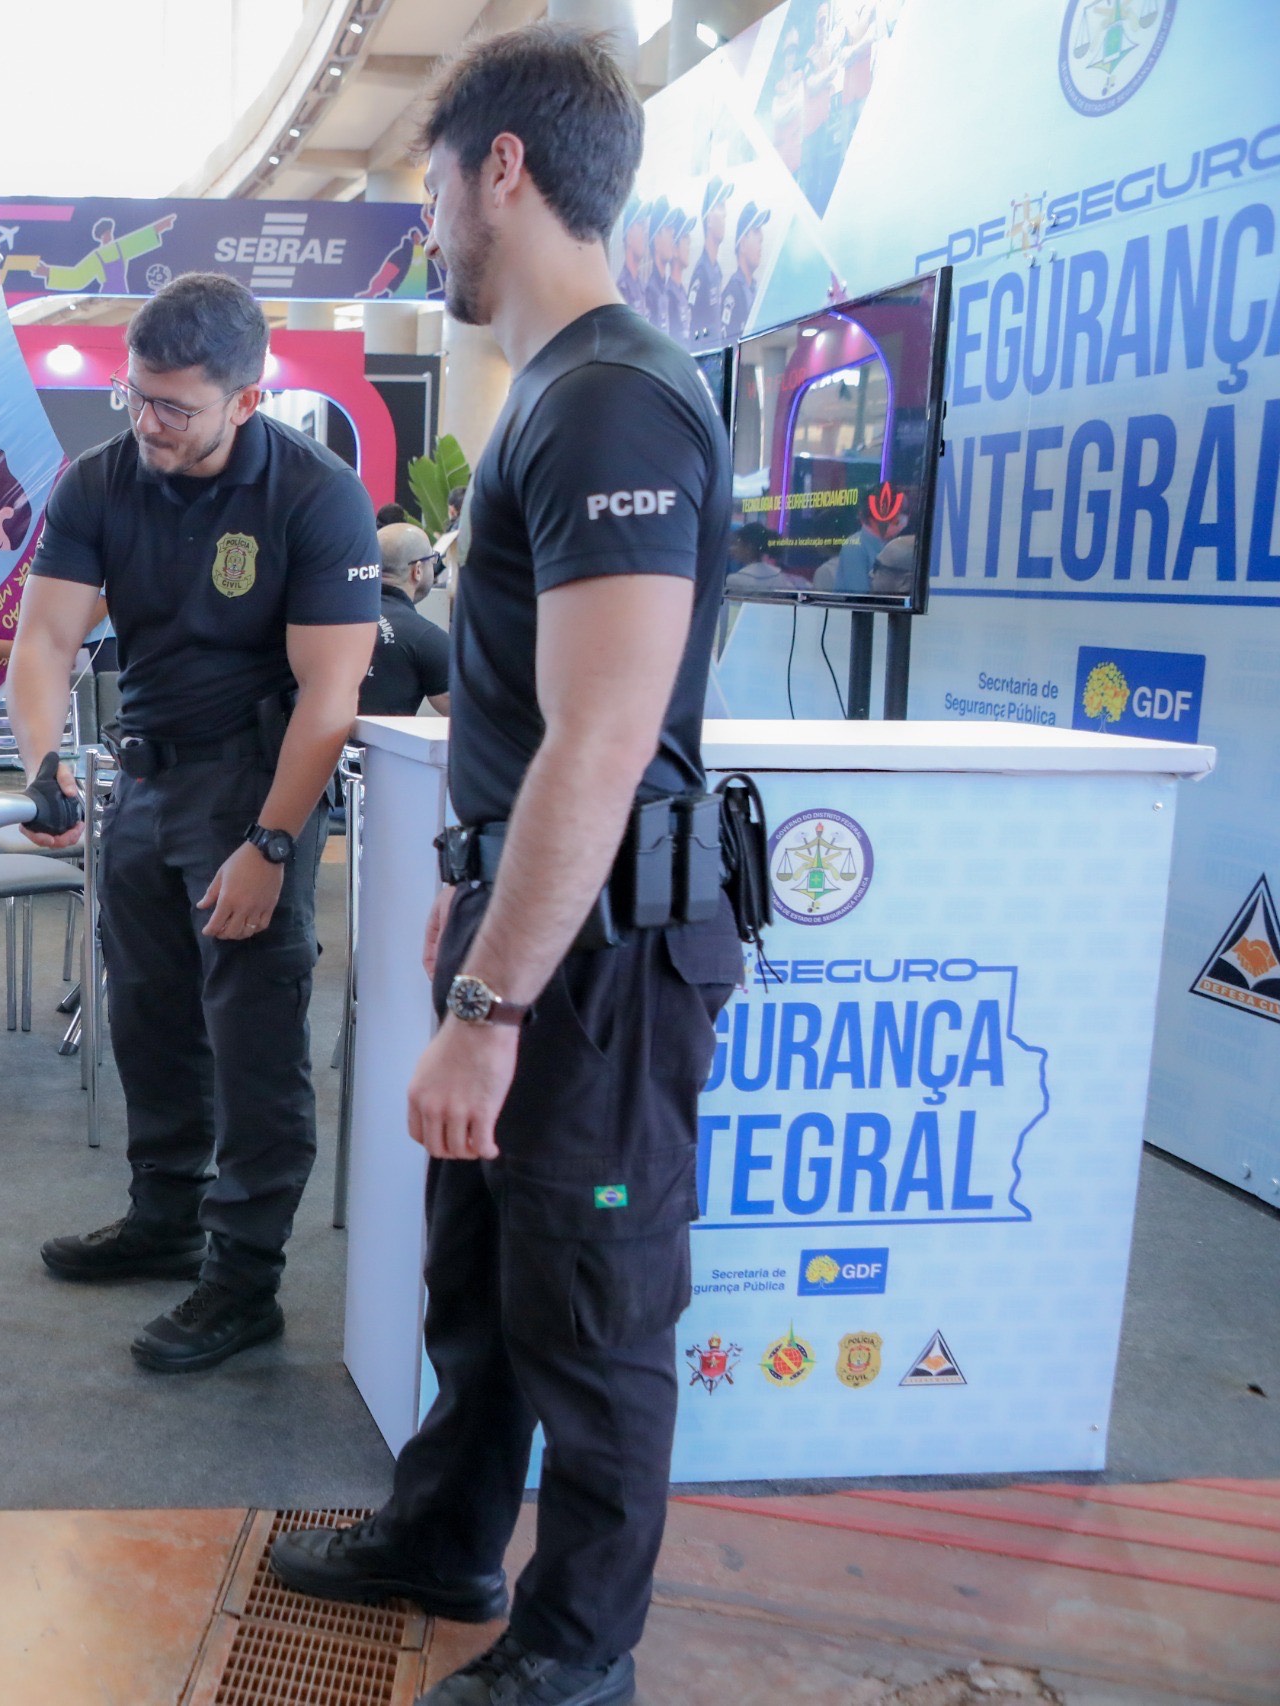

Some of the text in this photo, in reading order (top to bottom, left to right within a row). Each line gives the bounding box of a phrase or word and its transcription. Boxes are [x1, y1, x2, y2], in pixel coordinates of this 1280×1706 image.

[214, 236, 347, 264] SEBRAE
[947, 216, 1006, 266] DF
[587, 489, 677, 520] PCDF
[931, 400, 1280, 585] NTEGRAL
[226, 537, 250, 549] POLÍCIA
[222, 580, 242, 589] CIVIL
[1041, 680, 1059, 699] de
[1007, 700, 1056, 726] Pública
[1132, 686, 1193, 722] GDF
[775, 812, 863, 840] GOVERNO DO DISTRITO FEDERAL
[790, 911, 813, 922] ESTADO
[822, 899, 856, 922] SEGURANÇA
[753, 958, 979, 984] SEGURO
[1203, 980, 1255, 1006] DEFESA
[697, 1110, 994, 1217] TEGRAL
[712, 1268, 786, 1279] Secretaria de
[842, 1263, 882, 1279] GDF
[692, 1281, 785, 1295] gurança Pública
[847, 1337, 875, 1346] POLÍCIA
[846, 1374, 869, 1382] CIVIL
